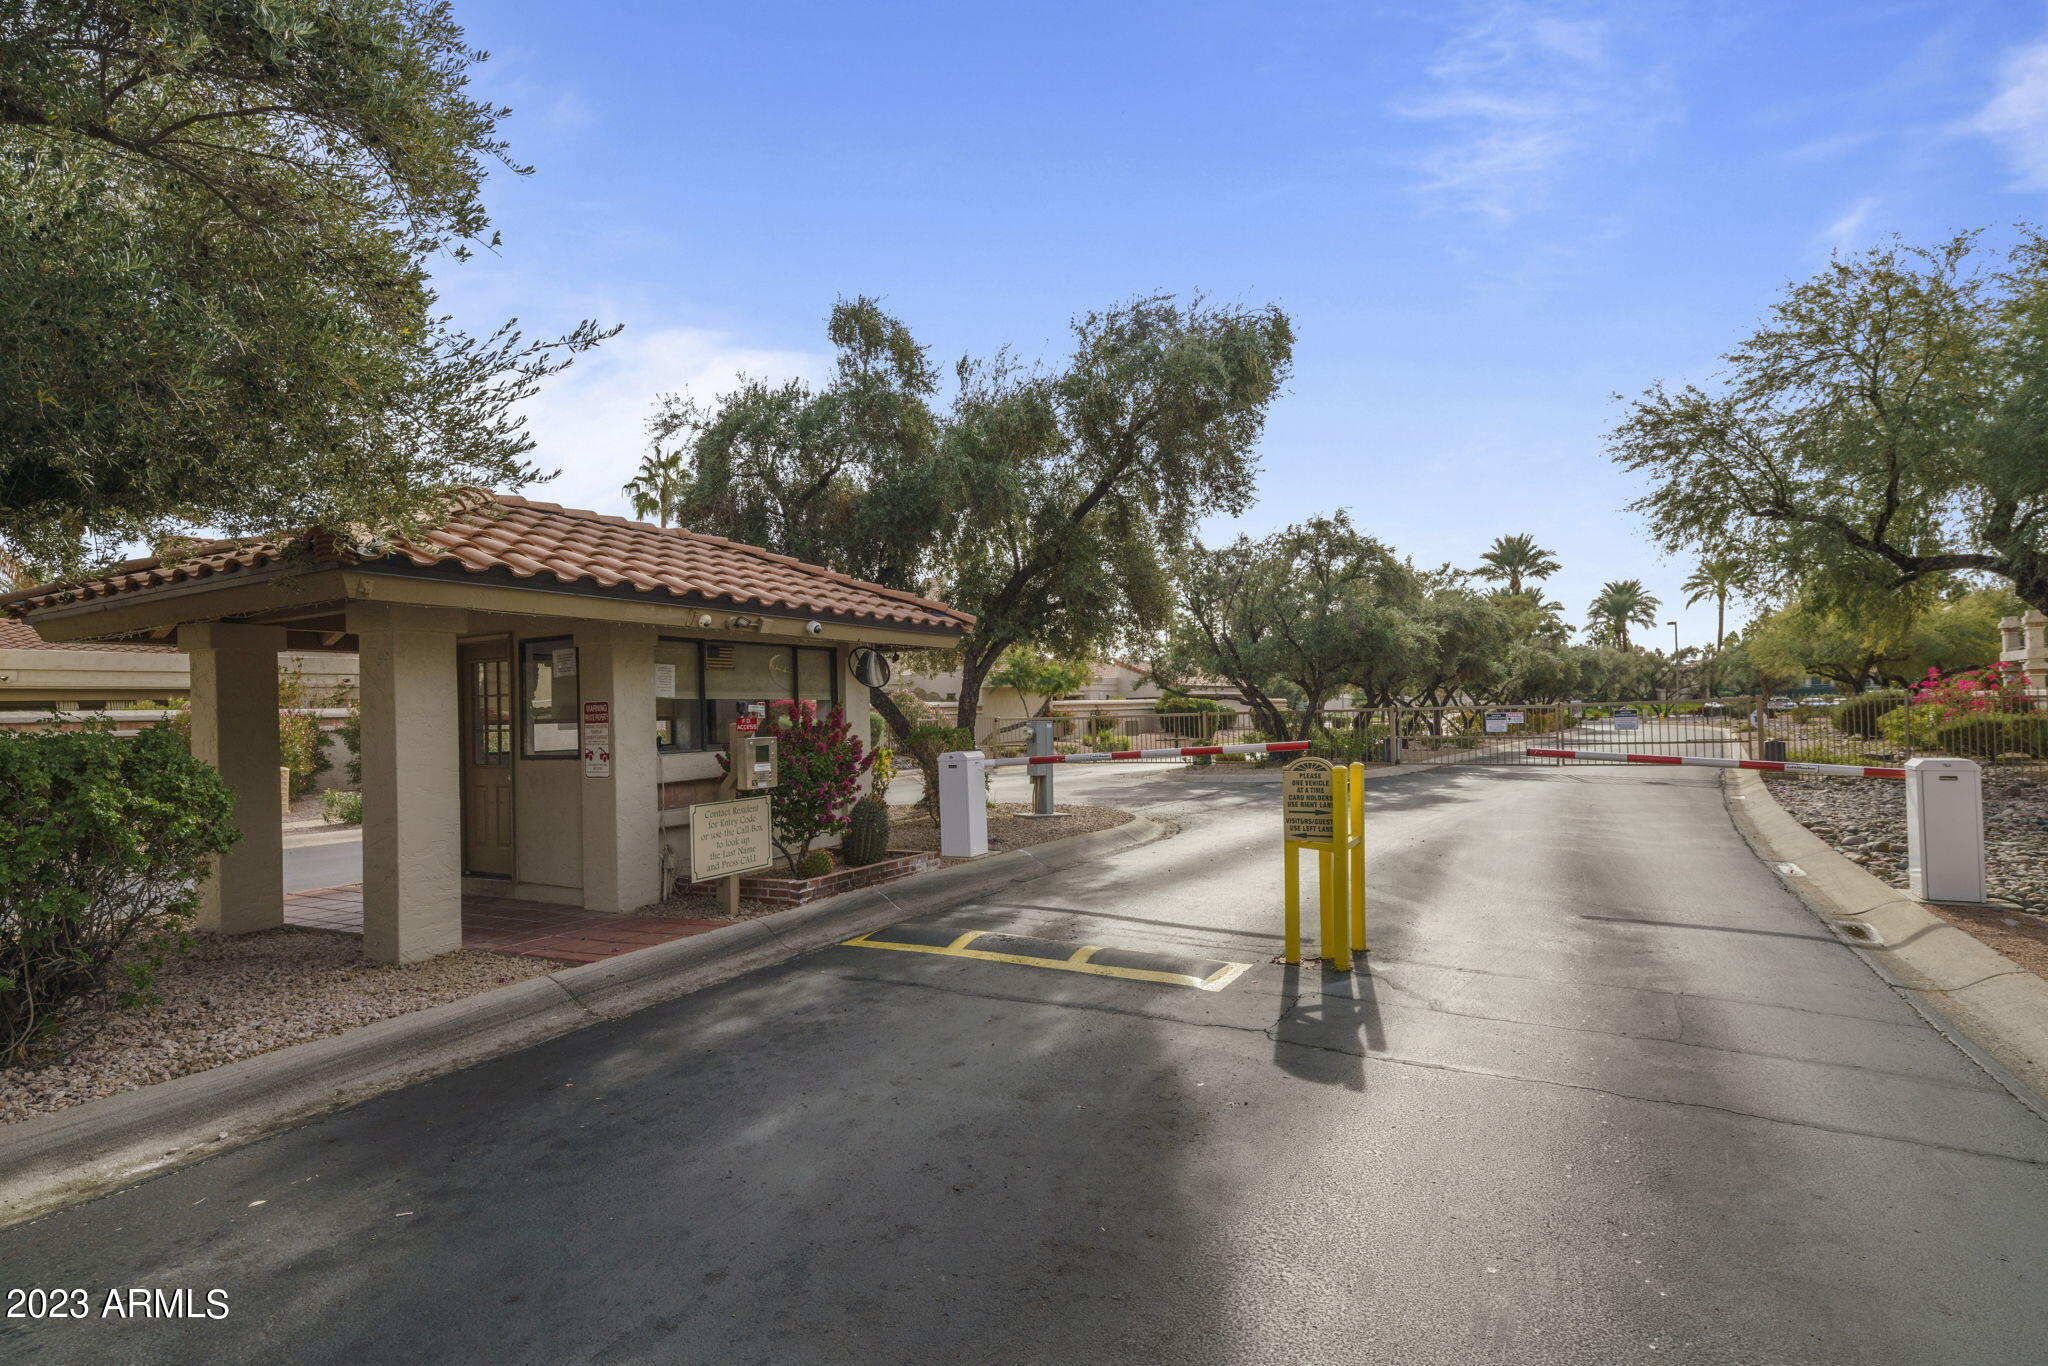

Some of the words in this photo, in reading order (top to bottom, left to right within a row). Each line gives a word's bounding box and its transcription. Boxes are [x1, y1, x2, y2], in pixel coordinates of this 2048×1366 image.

[704, 809, 730, 818] Contact
[732, 805, 759, 814] Resident
[720, 819, 738, 827] Entry
[739, 815, 757, 823] Code
[736, 826, 750, 834] Call
[725, 838, 739, 847] look
[742, 837, 750, 846] up
[723, 849, 736, 857] Last
[738, 846, 756, 855] Name
[706, 863, 720, 872] and
[722, 860, 739, 868] Press
[740, 855, 757, 864] CALL
